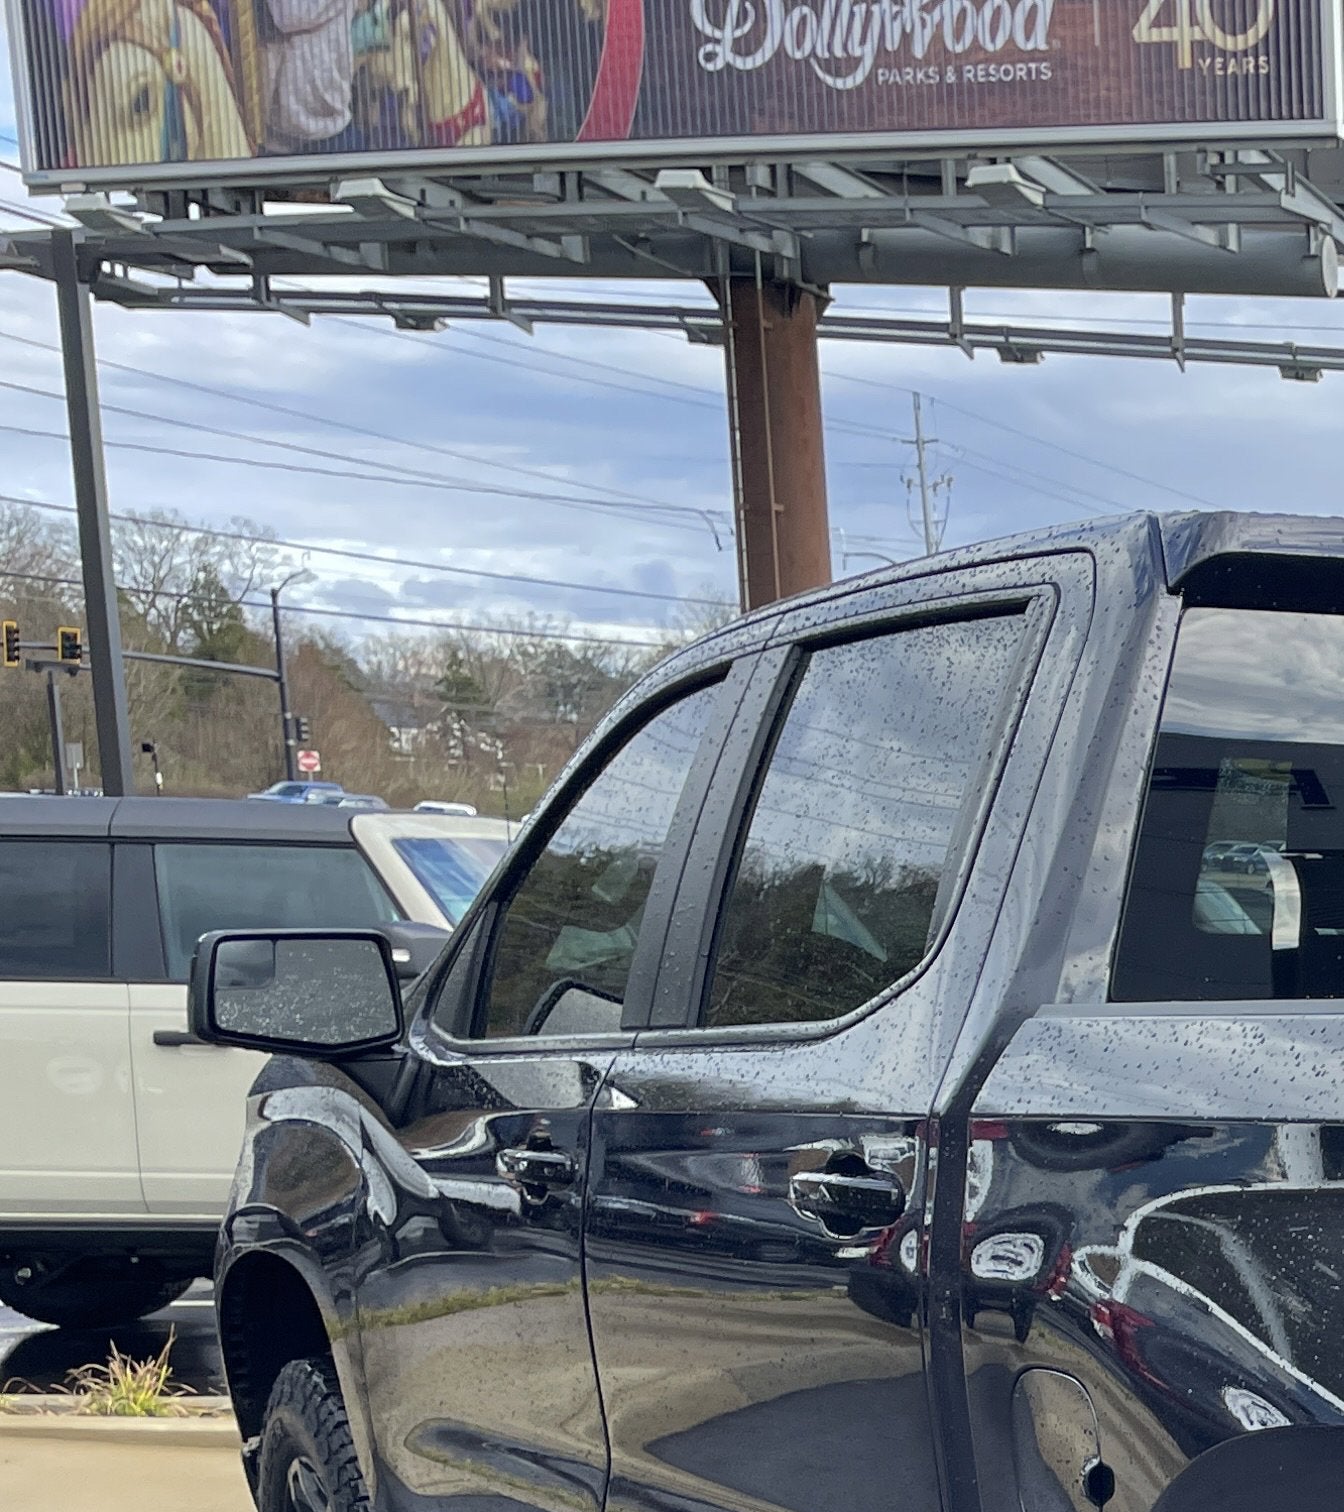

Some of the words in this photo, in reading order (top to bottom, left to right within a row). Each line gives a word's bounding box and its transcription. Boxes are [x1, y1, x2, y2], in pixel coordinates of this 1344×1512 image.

[1132, 0, 1274, 69] 40
[877, 66, 940, 86] PARKS
[945, 65, 957, 84] &
[963, 62, 1053, 83] RESORTS
[1198, 56, 1270, 76] YEARS
